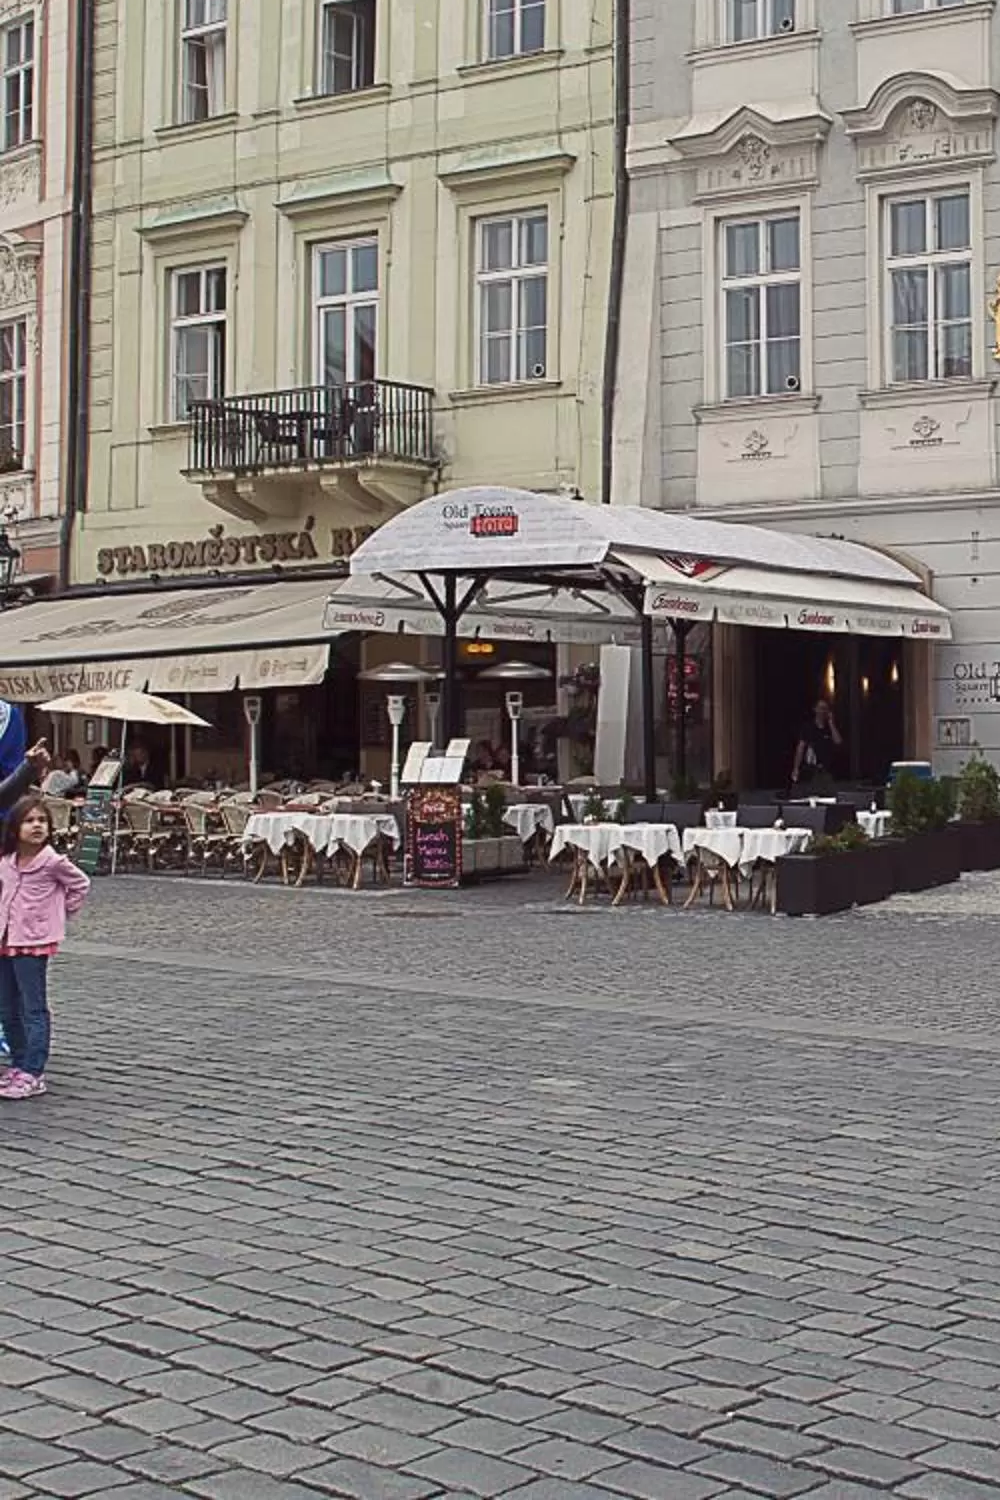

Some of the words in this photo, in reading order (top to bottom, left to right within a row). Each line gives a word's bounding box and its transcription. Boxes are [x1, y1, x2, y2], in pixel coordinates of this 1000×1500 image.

[442, 503, 469, 519] Old
[97, 515, 318, 575] STAROMĚSTSKÁ
[48, 664, 134, 694] RESTAURACE
[953, 662, 986, 680] Old
[416, 828, 449, 842] Lunch
